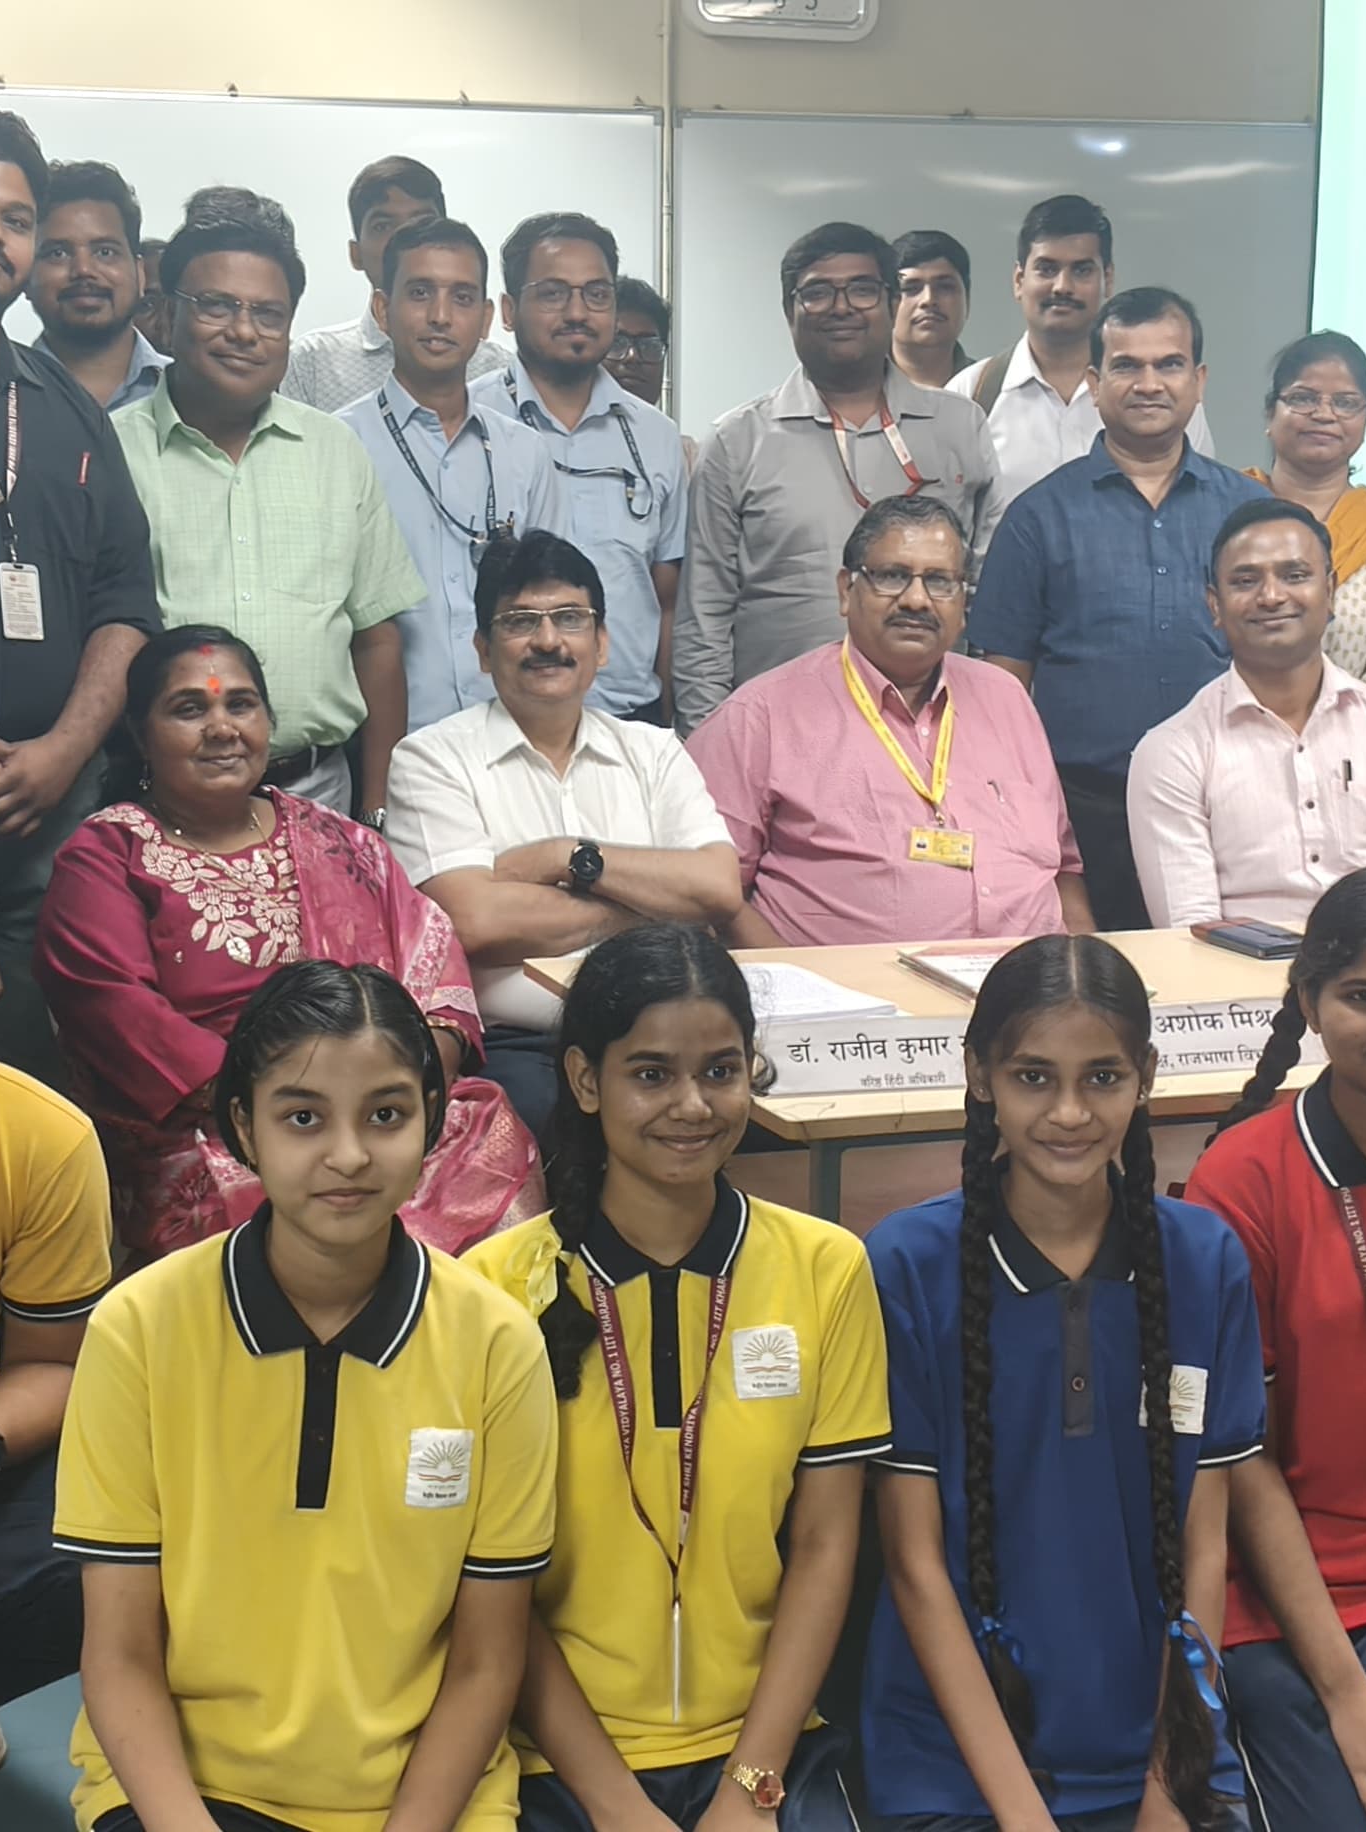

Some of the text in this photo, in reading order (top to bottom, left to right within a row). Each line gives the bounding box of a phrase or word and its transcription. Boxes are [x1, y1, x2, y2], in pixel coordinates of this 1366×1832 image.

[1154, 1005, 1226, 1034] अशोक
[786, 1036, 820, 1064] डॉ.
[826, 1032, 889, 1061] राजीव
[895, 1035, 953, 1064] कुमार
[1176, 1050, 1236, 1068] राजभाषा
